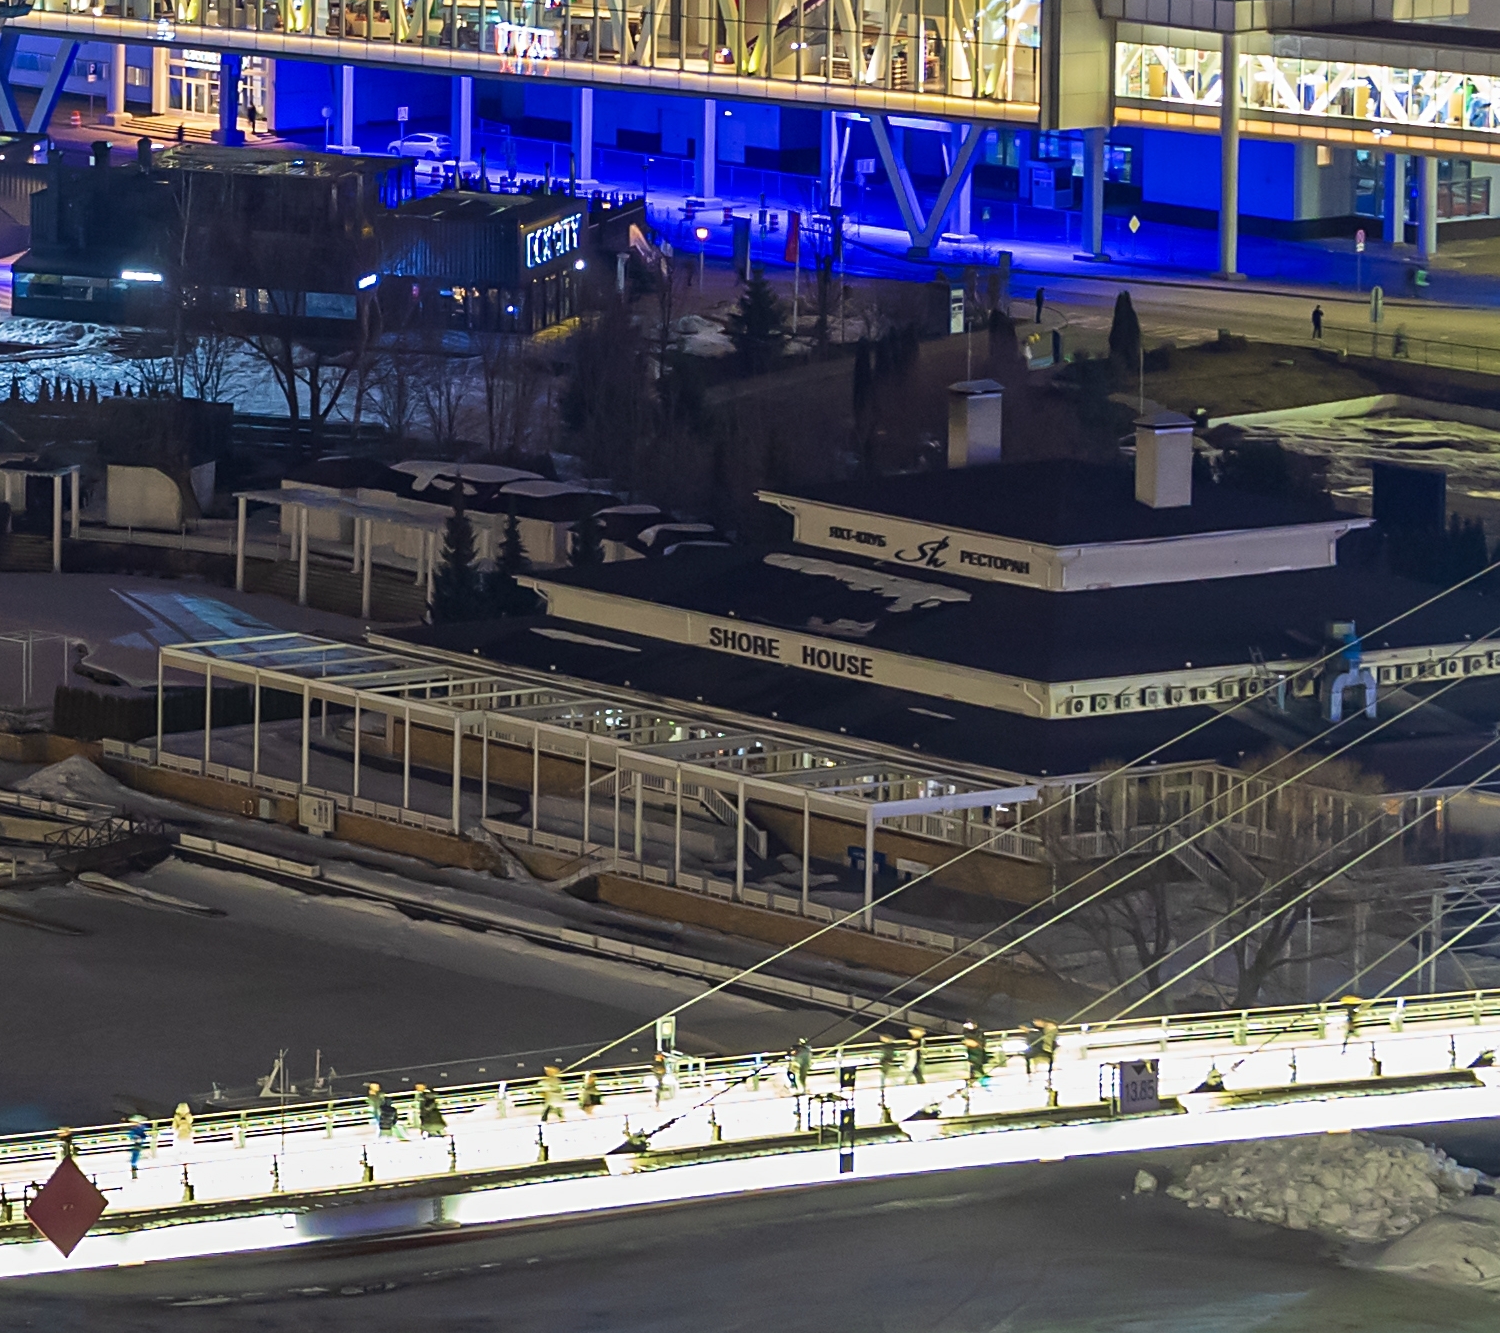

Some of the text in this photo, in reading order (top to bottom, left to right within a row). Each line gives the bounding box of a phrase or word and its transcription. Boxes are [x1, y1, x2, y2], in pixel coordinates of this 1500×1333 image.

[828, 526, 887, 548] ЯХТ-КЛУБ
[960, 549, 1031, 575] РЕСТОРАН
[708, 626, 875, 679] SHORE HOUSE
